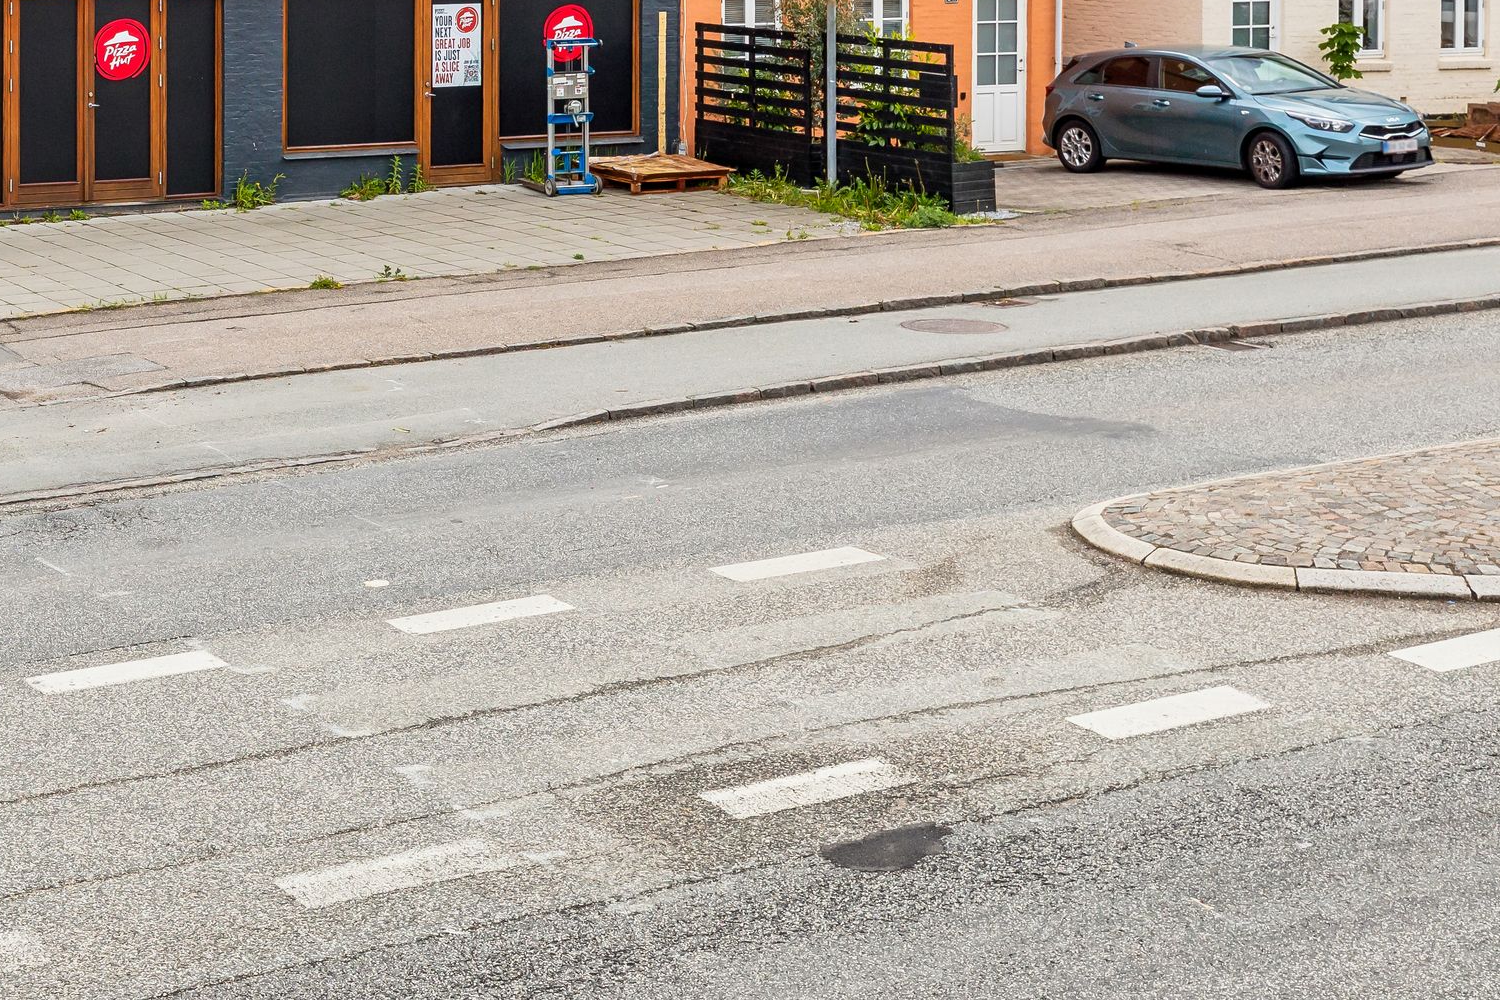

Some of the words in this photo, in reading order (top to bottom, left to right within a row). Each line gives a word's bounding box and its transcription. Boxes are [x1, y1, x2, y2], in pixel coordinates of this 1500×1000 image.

[435, 15, 453, 26] YOUR
[435, 27, 452, 38] NEXT
[553, 27, 582, 40] Pizza
[435, 38, 456, 49] GREAT
[457, 37, 471, 49] JOB
[103, 43, 138, 62] Pizza
[435, 50, 442, 61] IS
[443, 50, 461, 61] JUST
[109, 53, 136, 70] Hut
[435, 62, 440, 72] A
[441, 61, 460, 72] SLICE
[435, 73, 454, 84] AWAY
